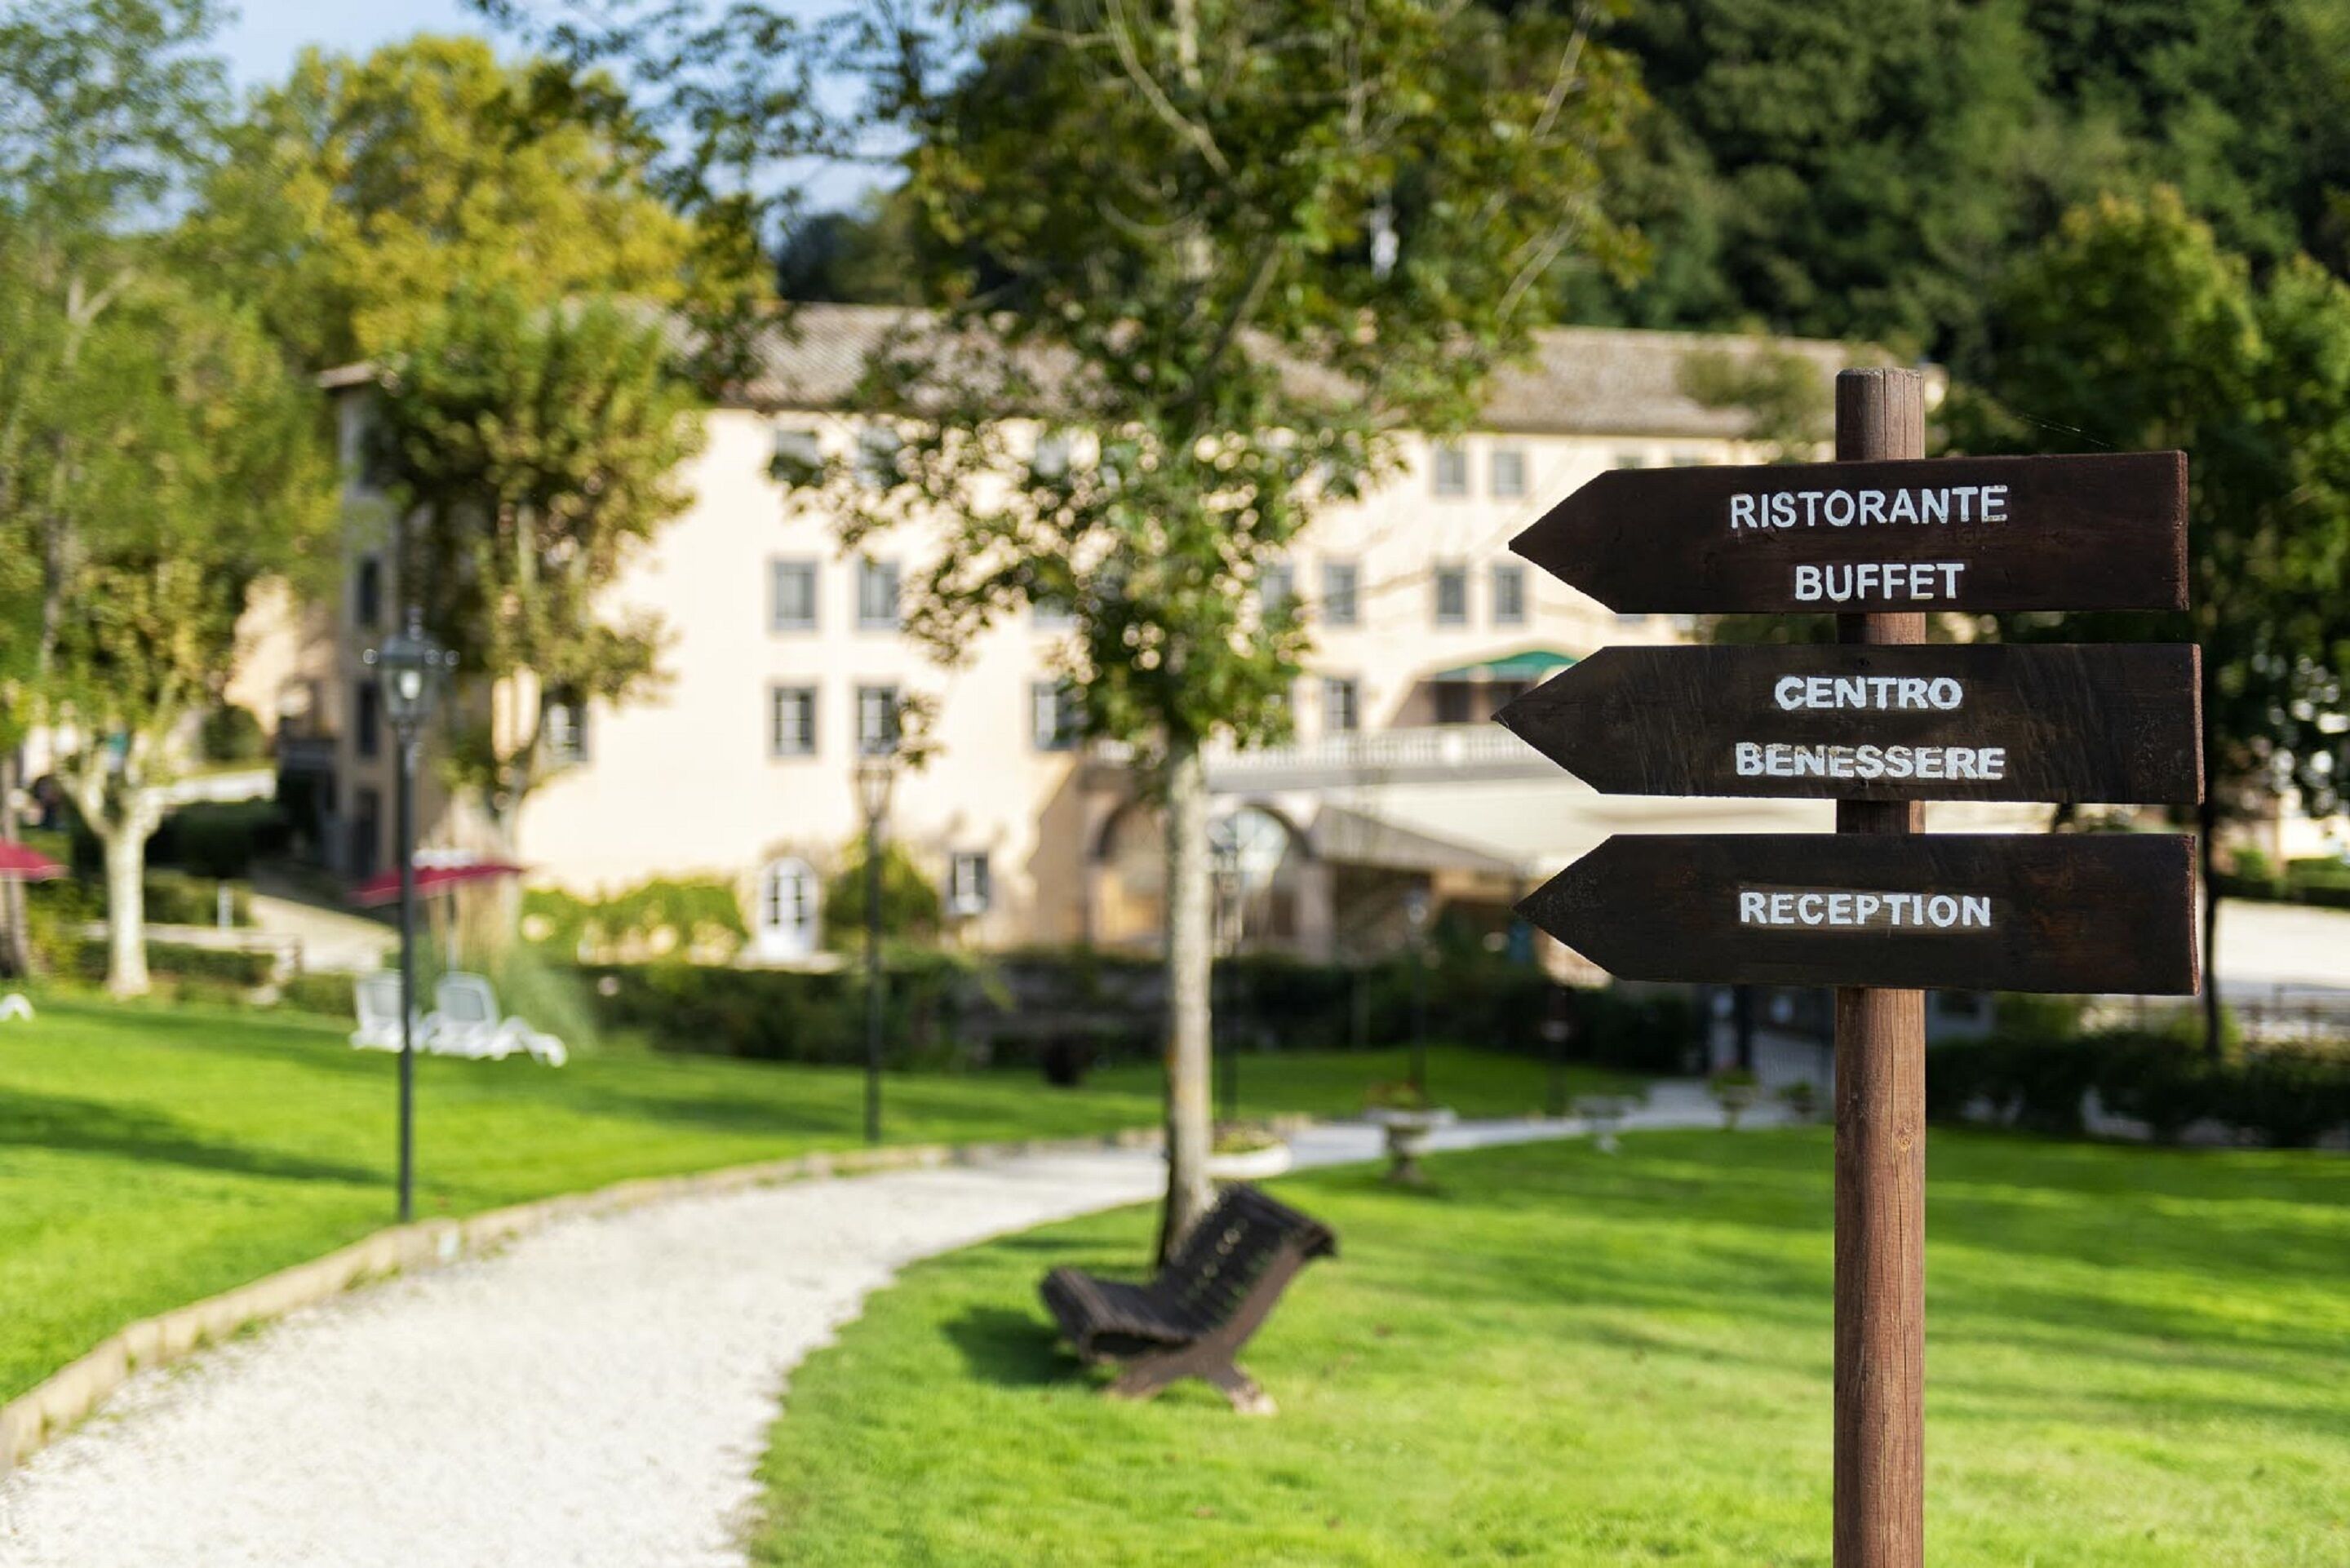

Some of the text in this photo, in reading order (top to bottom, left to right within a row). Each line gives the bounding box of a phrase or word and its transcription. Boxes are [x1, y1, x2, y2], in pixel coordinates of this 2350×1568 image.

[1731, 485, 2008, 529] RISTORANTE
[1795, 564, 1965, 601] BUFFET
[1775, 676, 1963, 711] CENTRO
[1736, 742, 2006, 780] BENESSERE
[1740, 892, 1991, 928] RECEPTION
